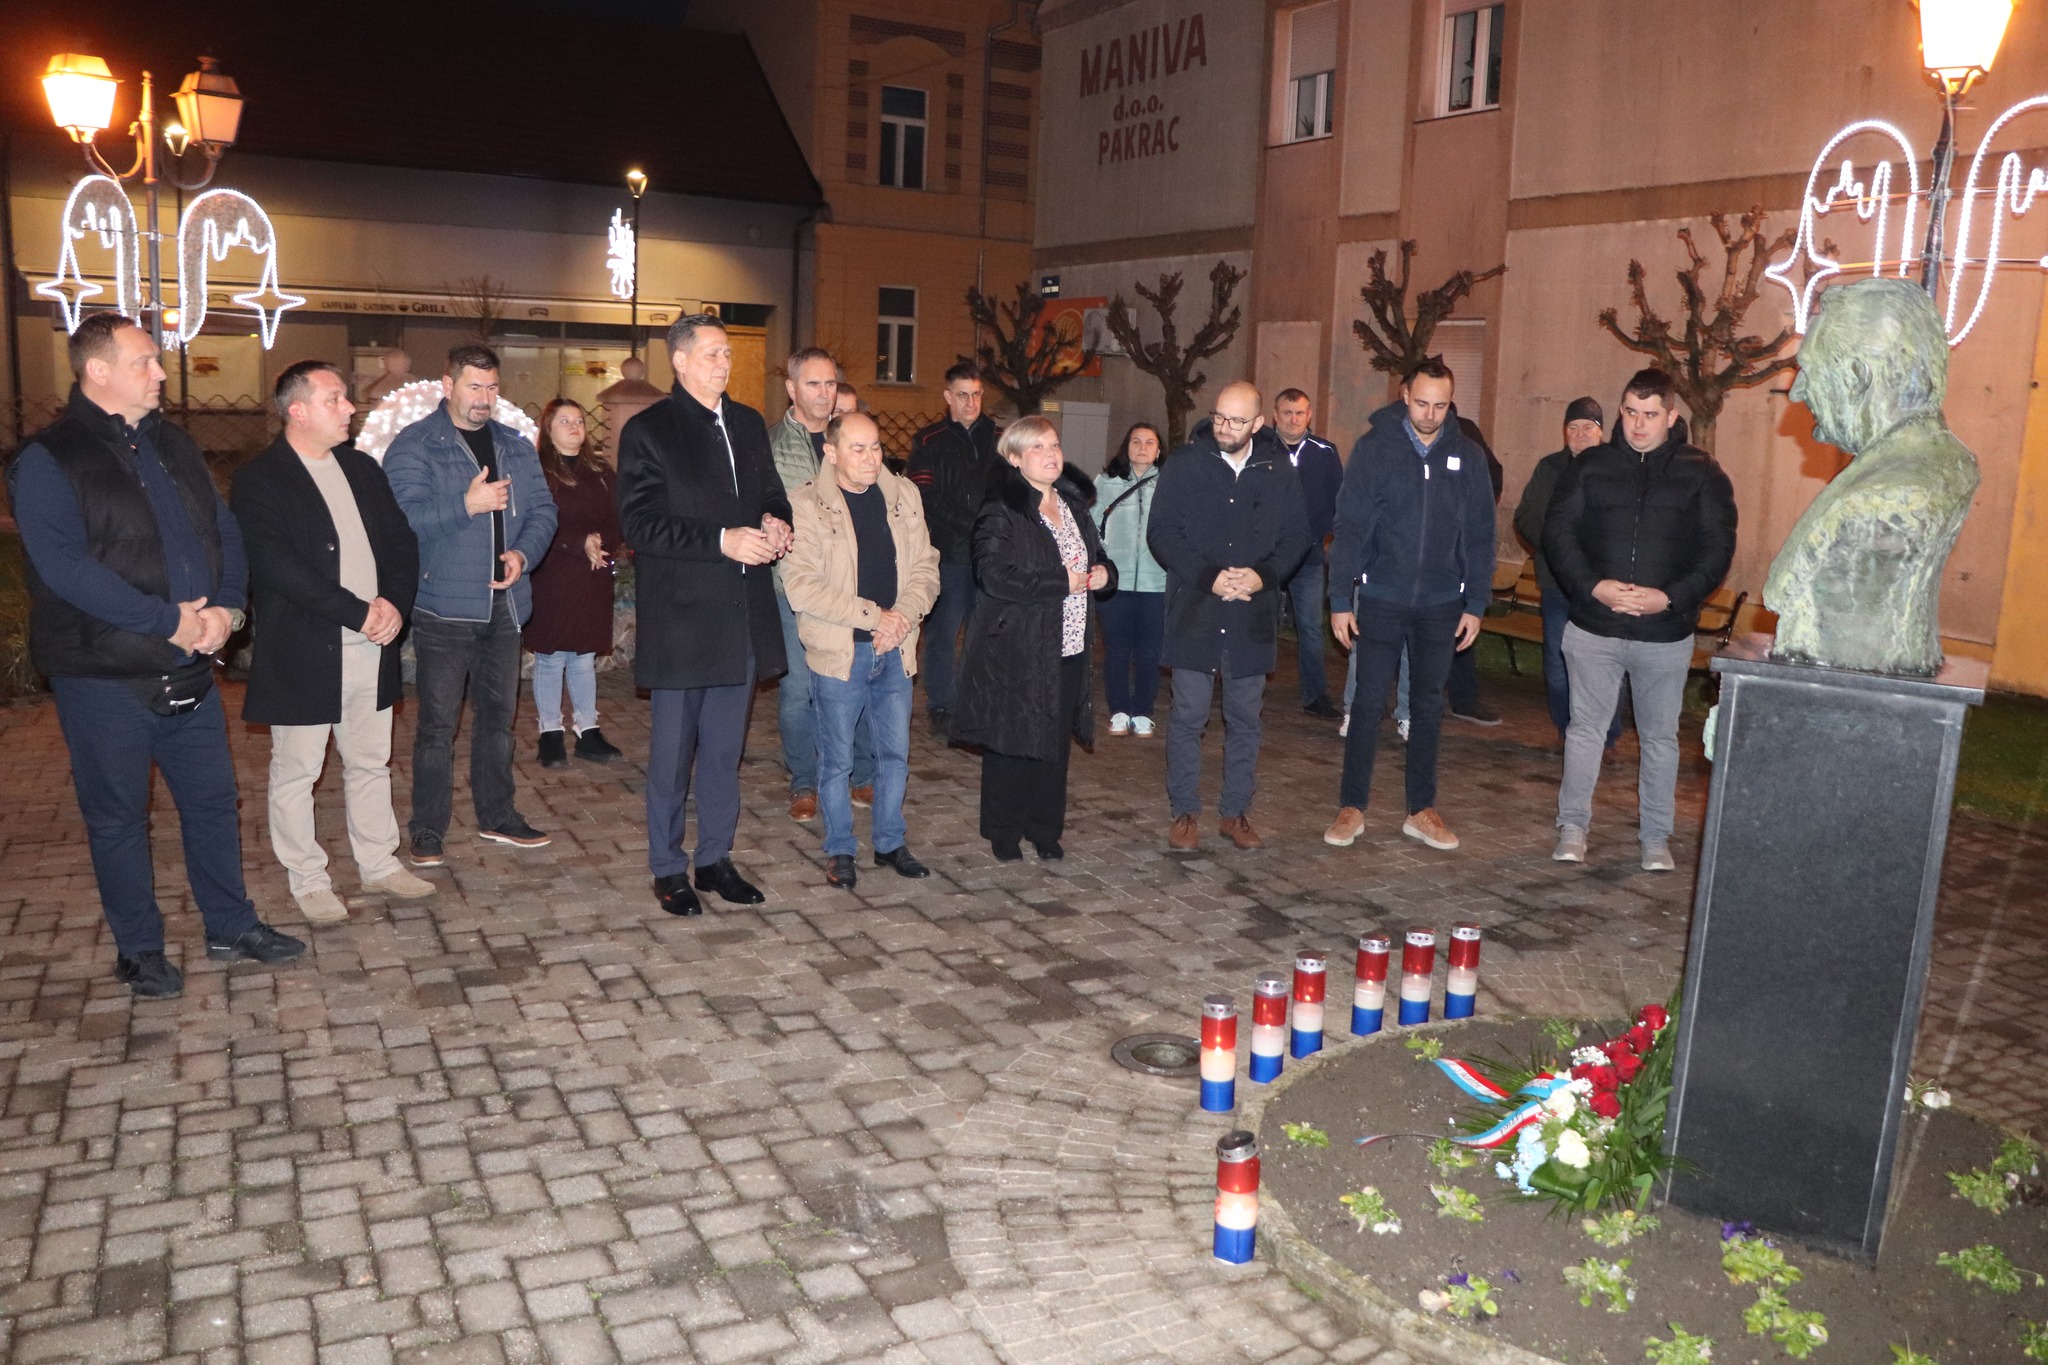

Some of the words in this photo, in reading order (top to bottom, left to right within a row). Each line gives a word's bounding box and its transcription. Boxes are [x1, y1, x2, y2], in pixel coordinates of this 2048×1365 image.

[1080, 13, 1207, 98] MANIVA
[1113, 95, 1164, 121] d.o.o.
[1098, 115, 1180, 166] PAKRAC
[411, 301, 448, 313] GRILL
